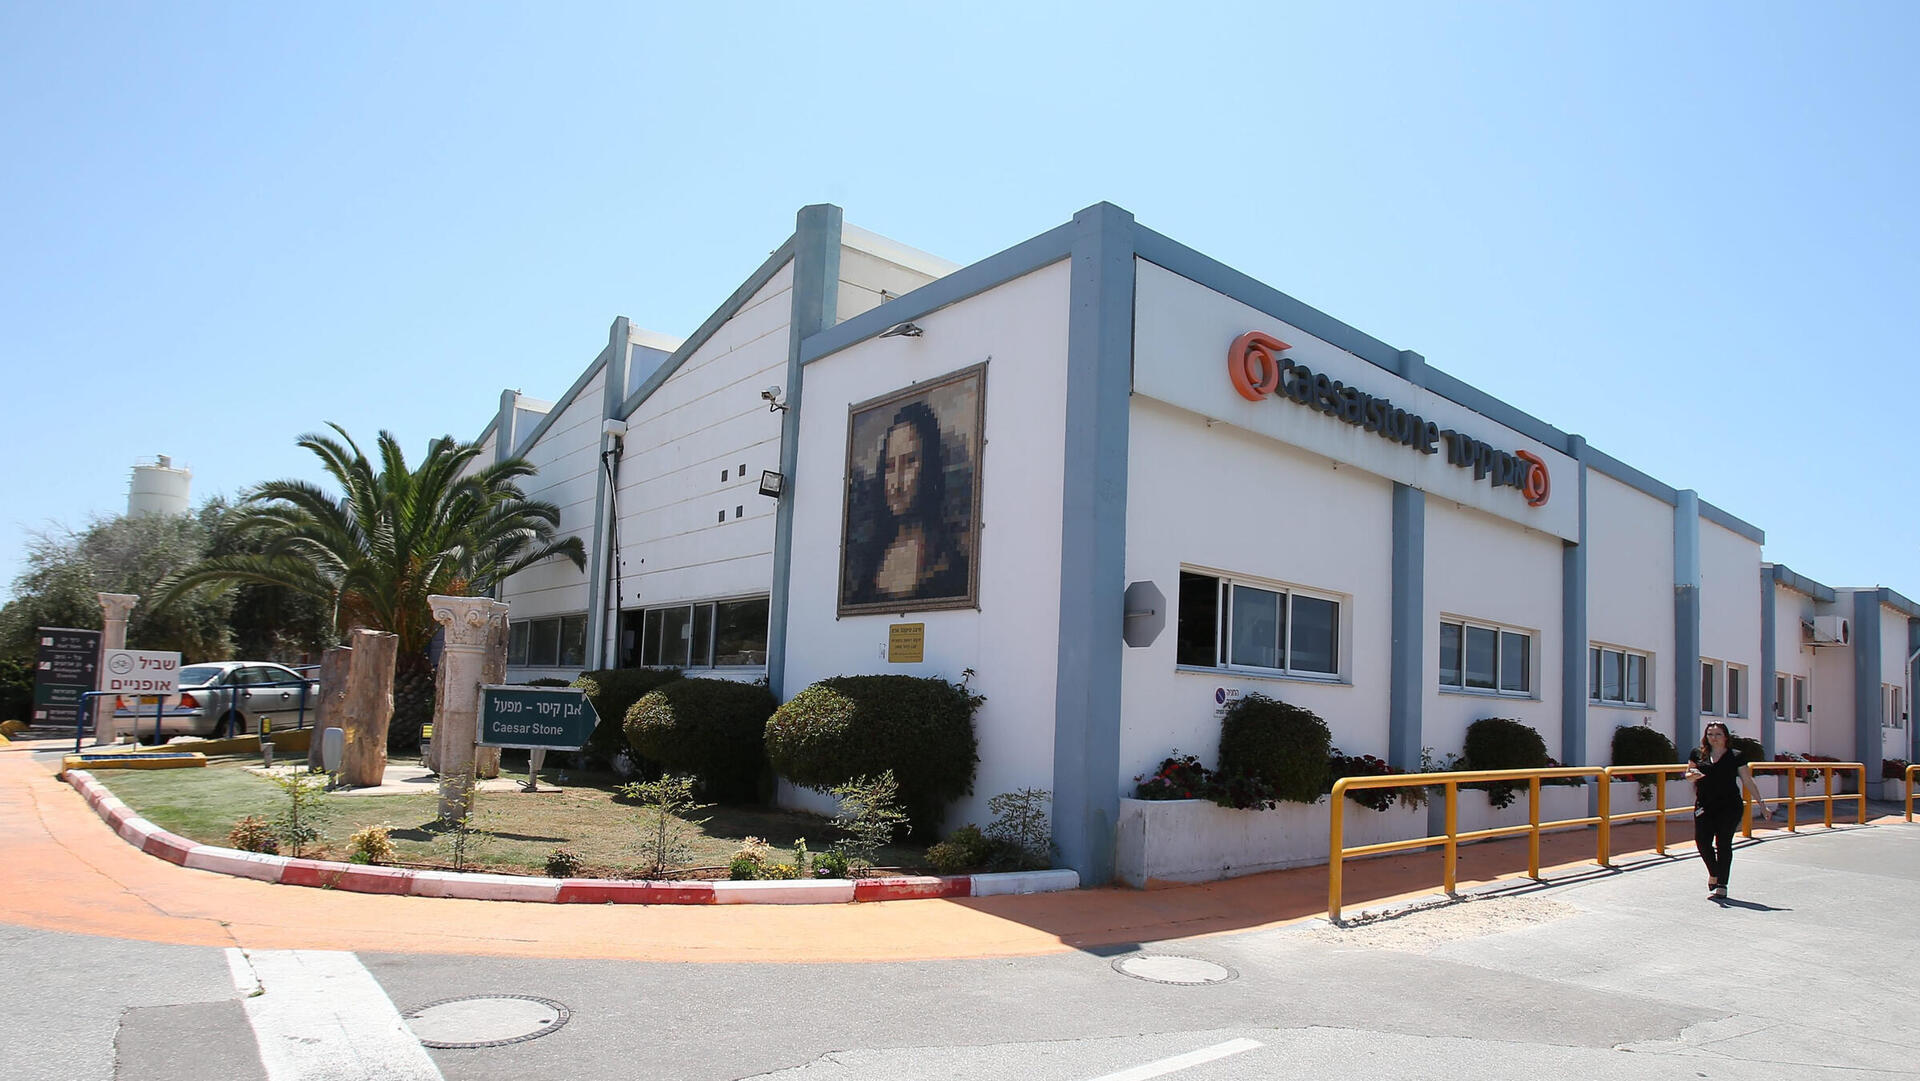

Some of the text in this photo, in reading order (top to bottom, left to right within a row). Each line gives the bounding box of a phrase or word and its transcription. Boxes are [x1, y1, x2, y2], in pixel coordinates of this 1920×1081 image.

[1275, 358, 1440, 454] caesarstone
[139, 656, 177, 671] שביל
[111, 679, 172, 691] אופניים
[493, 697, 522, 713] מפעל
[536, 702, 560, 717] קיסר
[564, 702, 582, 718] אבן
[492, 721, 563, 735] Caesar Stone
